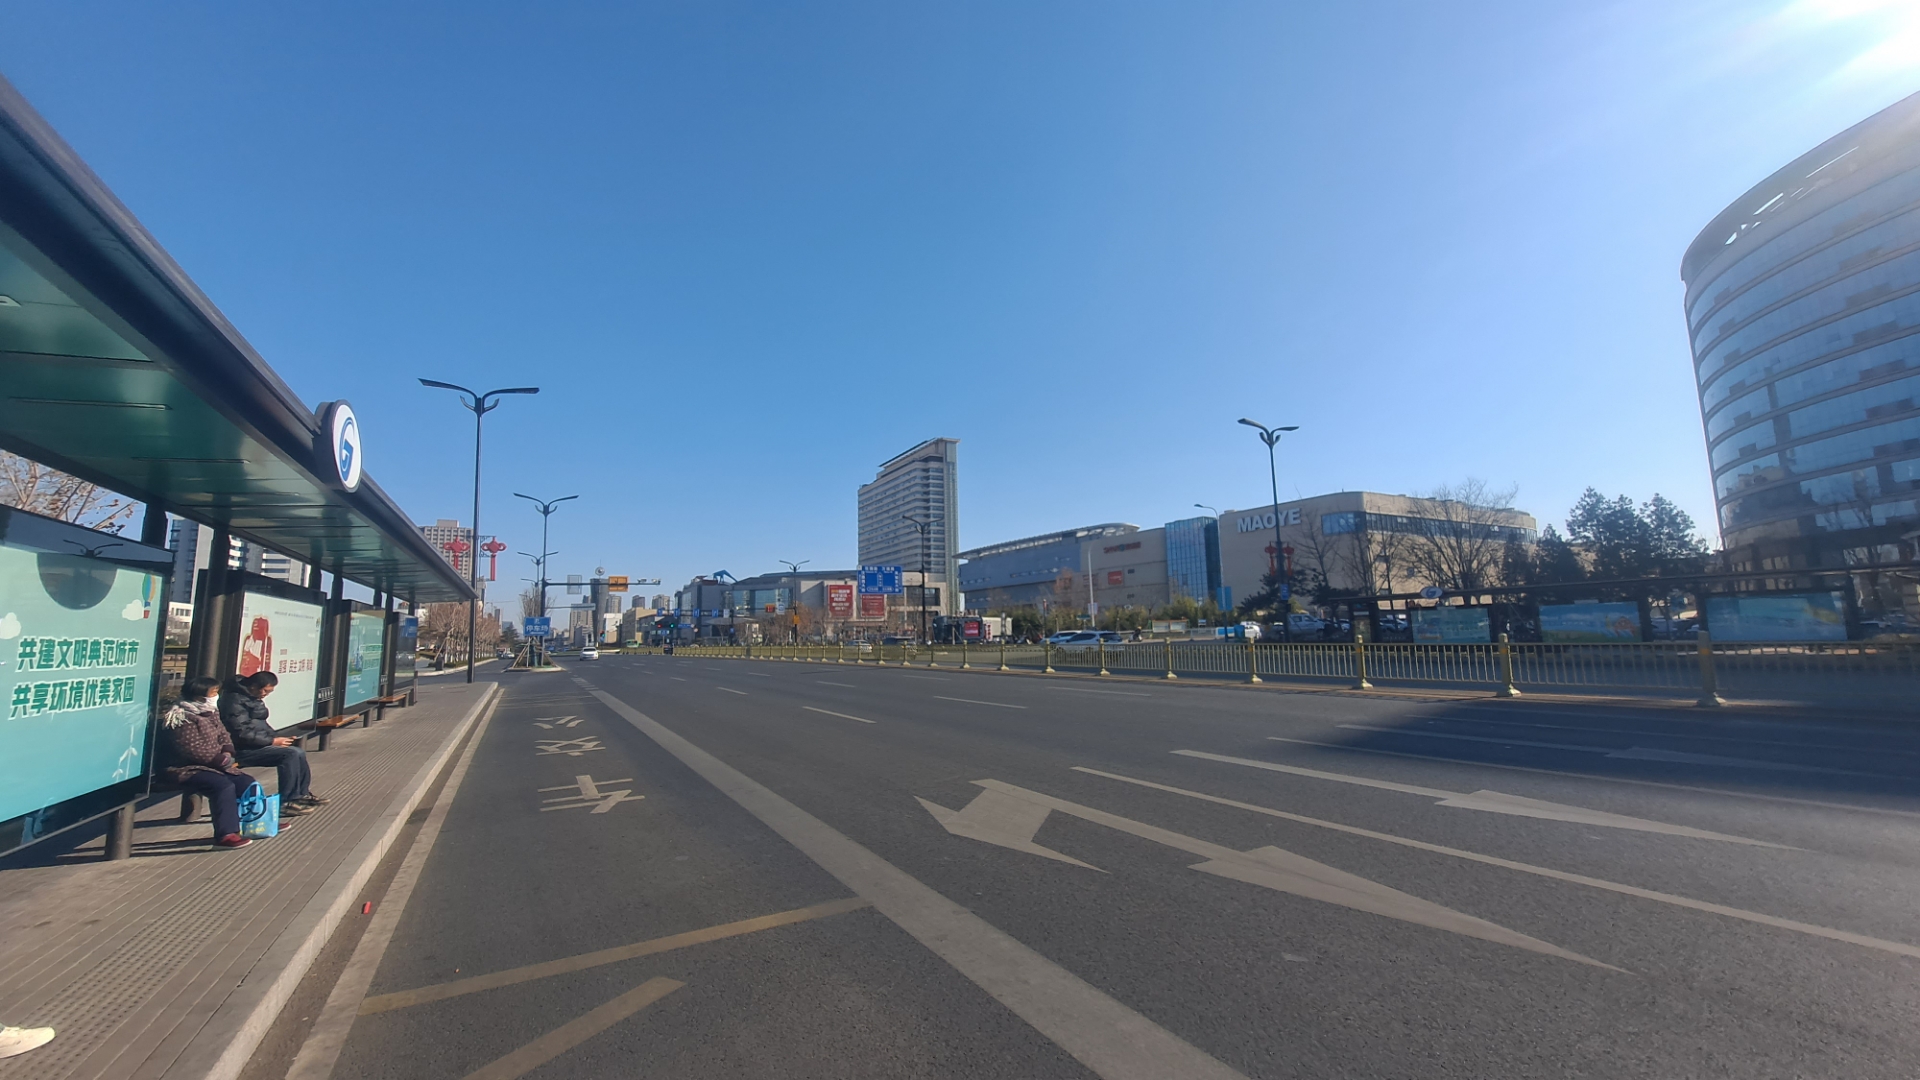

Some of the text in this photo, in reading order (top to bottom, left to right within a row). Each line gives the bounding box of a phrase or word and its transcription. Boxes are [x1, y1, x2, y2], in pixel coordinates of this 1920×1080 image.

[1237, 508, 1301, 533] MAOYE
[16, 637, 140, 672] 共建文明典范城市
[9, 676, 136, 720] 共享环境优美家园
